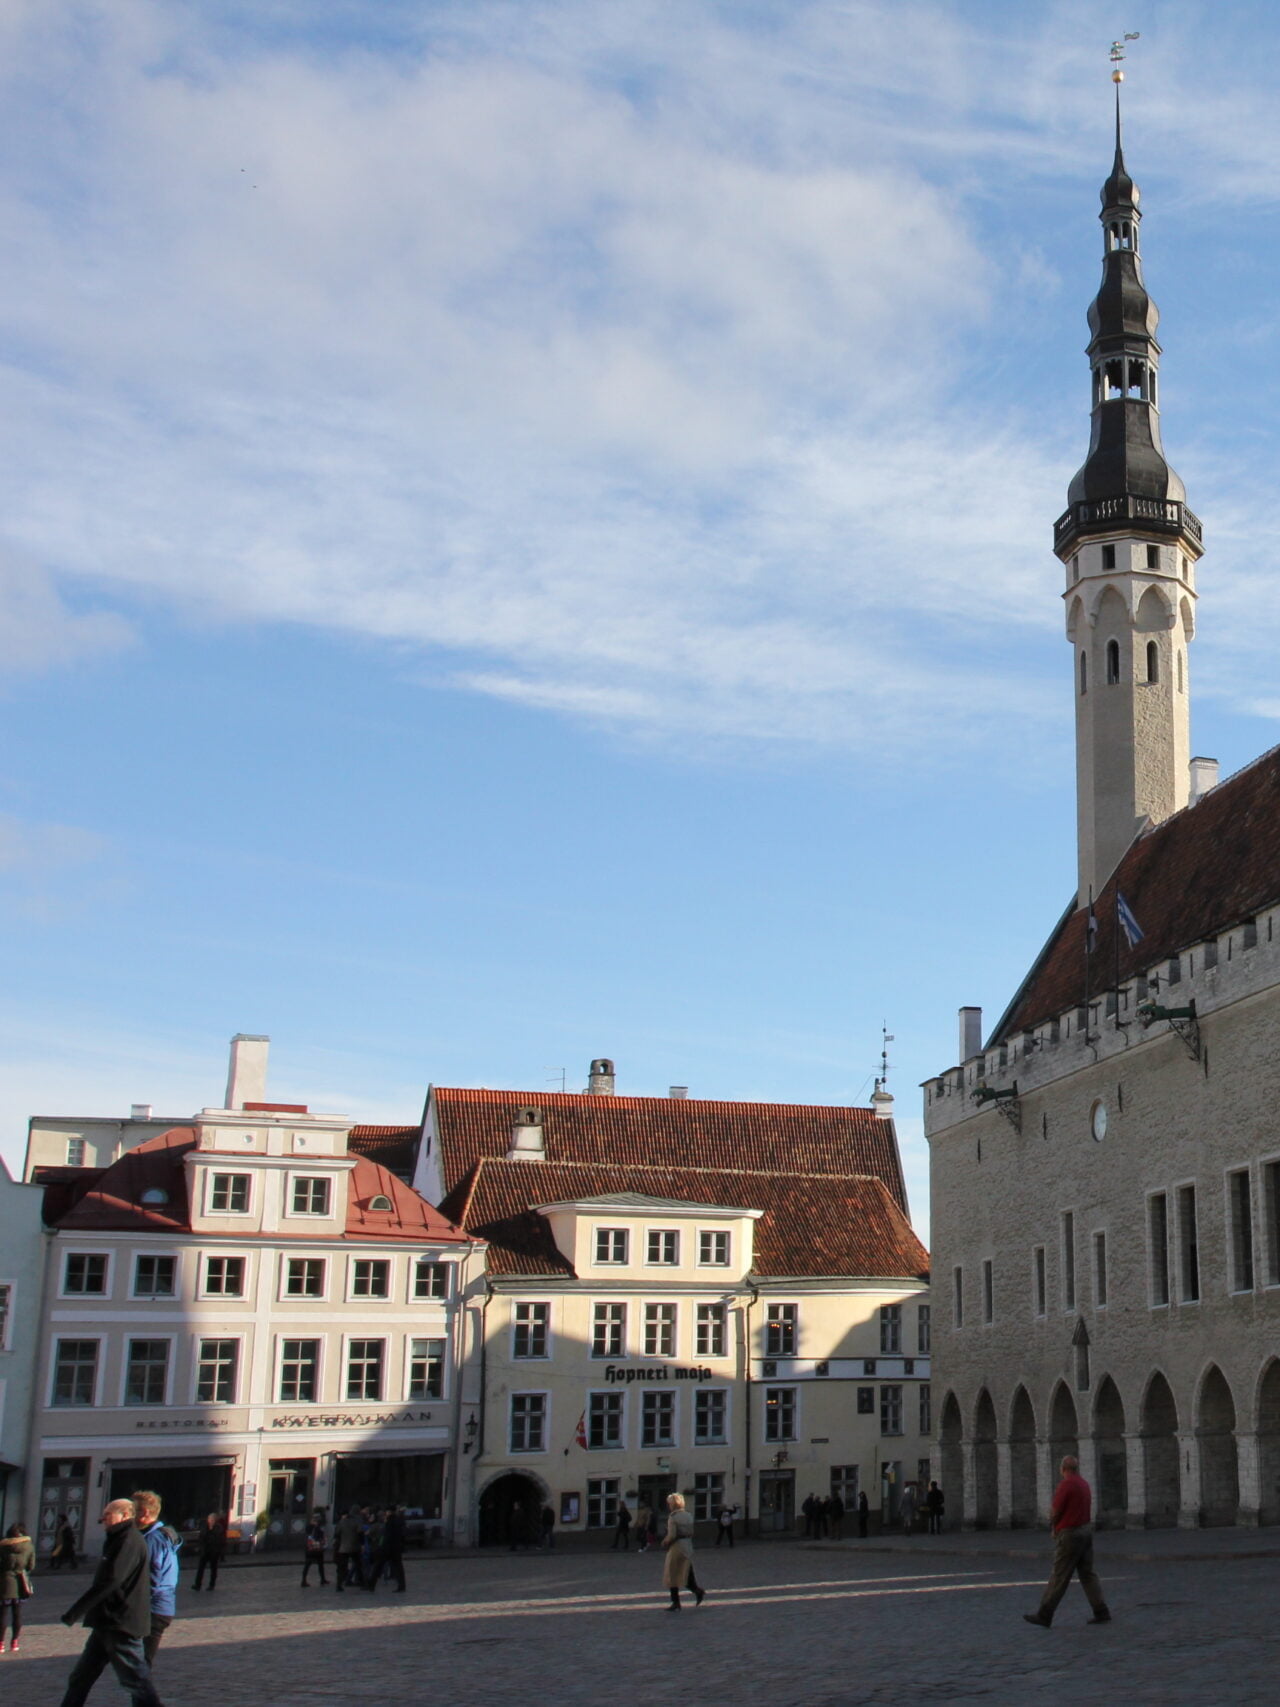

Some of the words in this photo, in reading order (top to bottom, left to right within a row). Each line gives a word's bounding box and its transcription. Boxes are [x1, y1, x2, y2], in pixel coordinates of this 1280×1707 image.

[605, 1364, 668, 1384] Hopneri
[675, 1365, 712, 1382] maja
[136, 1419, 229, 1428] RESTORAN
